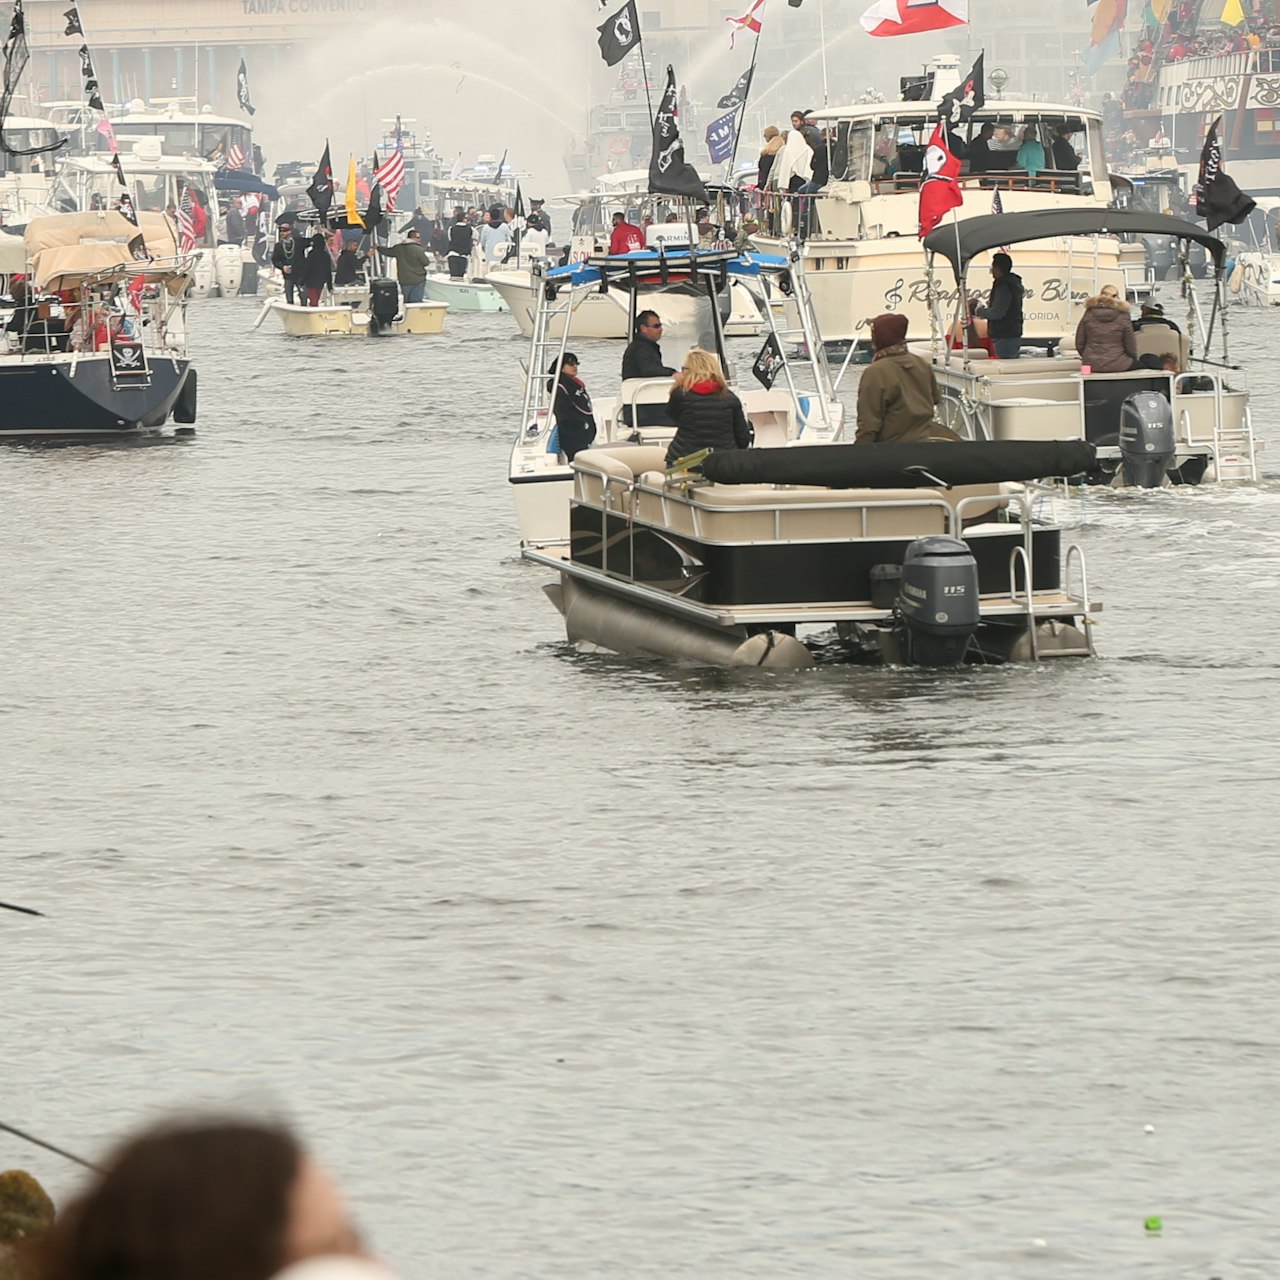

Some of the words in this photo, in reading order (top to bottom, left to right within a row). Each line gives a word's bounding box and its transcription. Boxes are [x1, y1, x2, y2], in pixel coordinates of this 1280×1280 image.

[242, 0, 285, 15] TAMPA
[1023, 312, 1060, 320] LORIDA
[943, 585, 966, 594] 115
